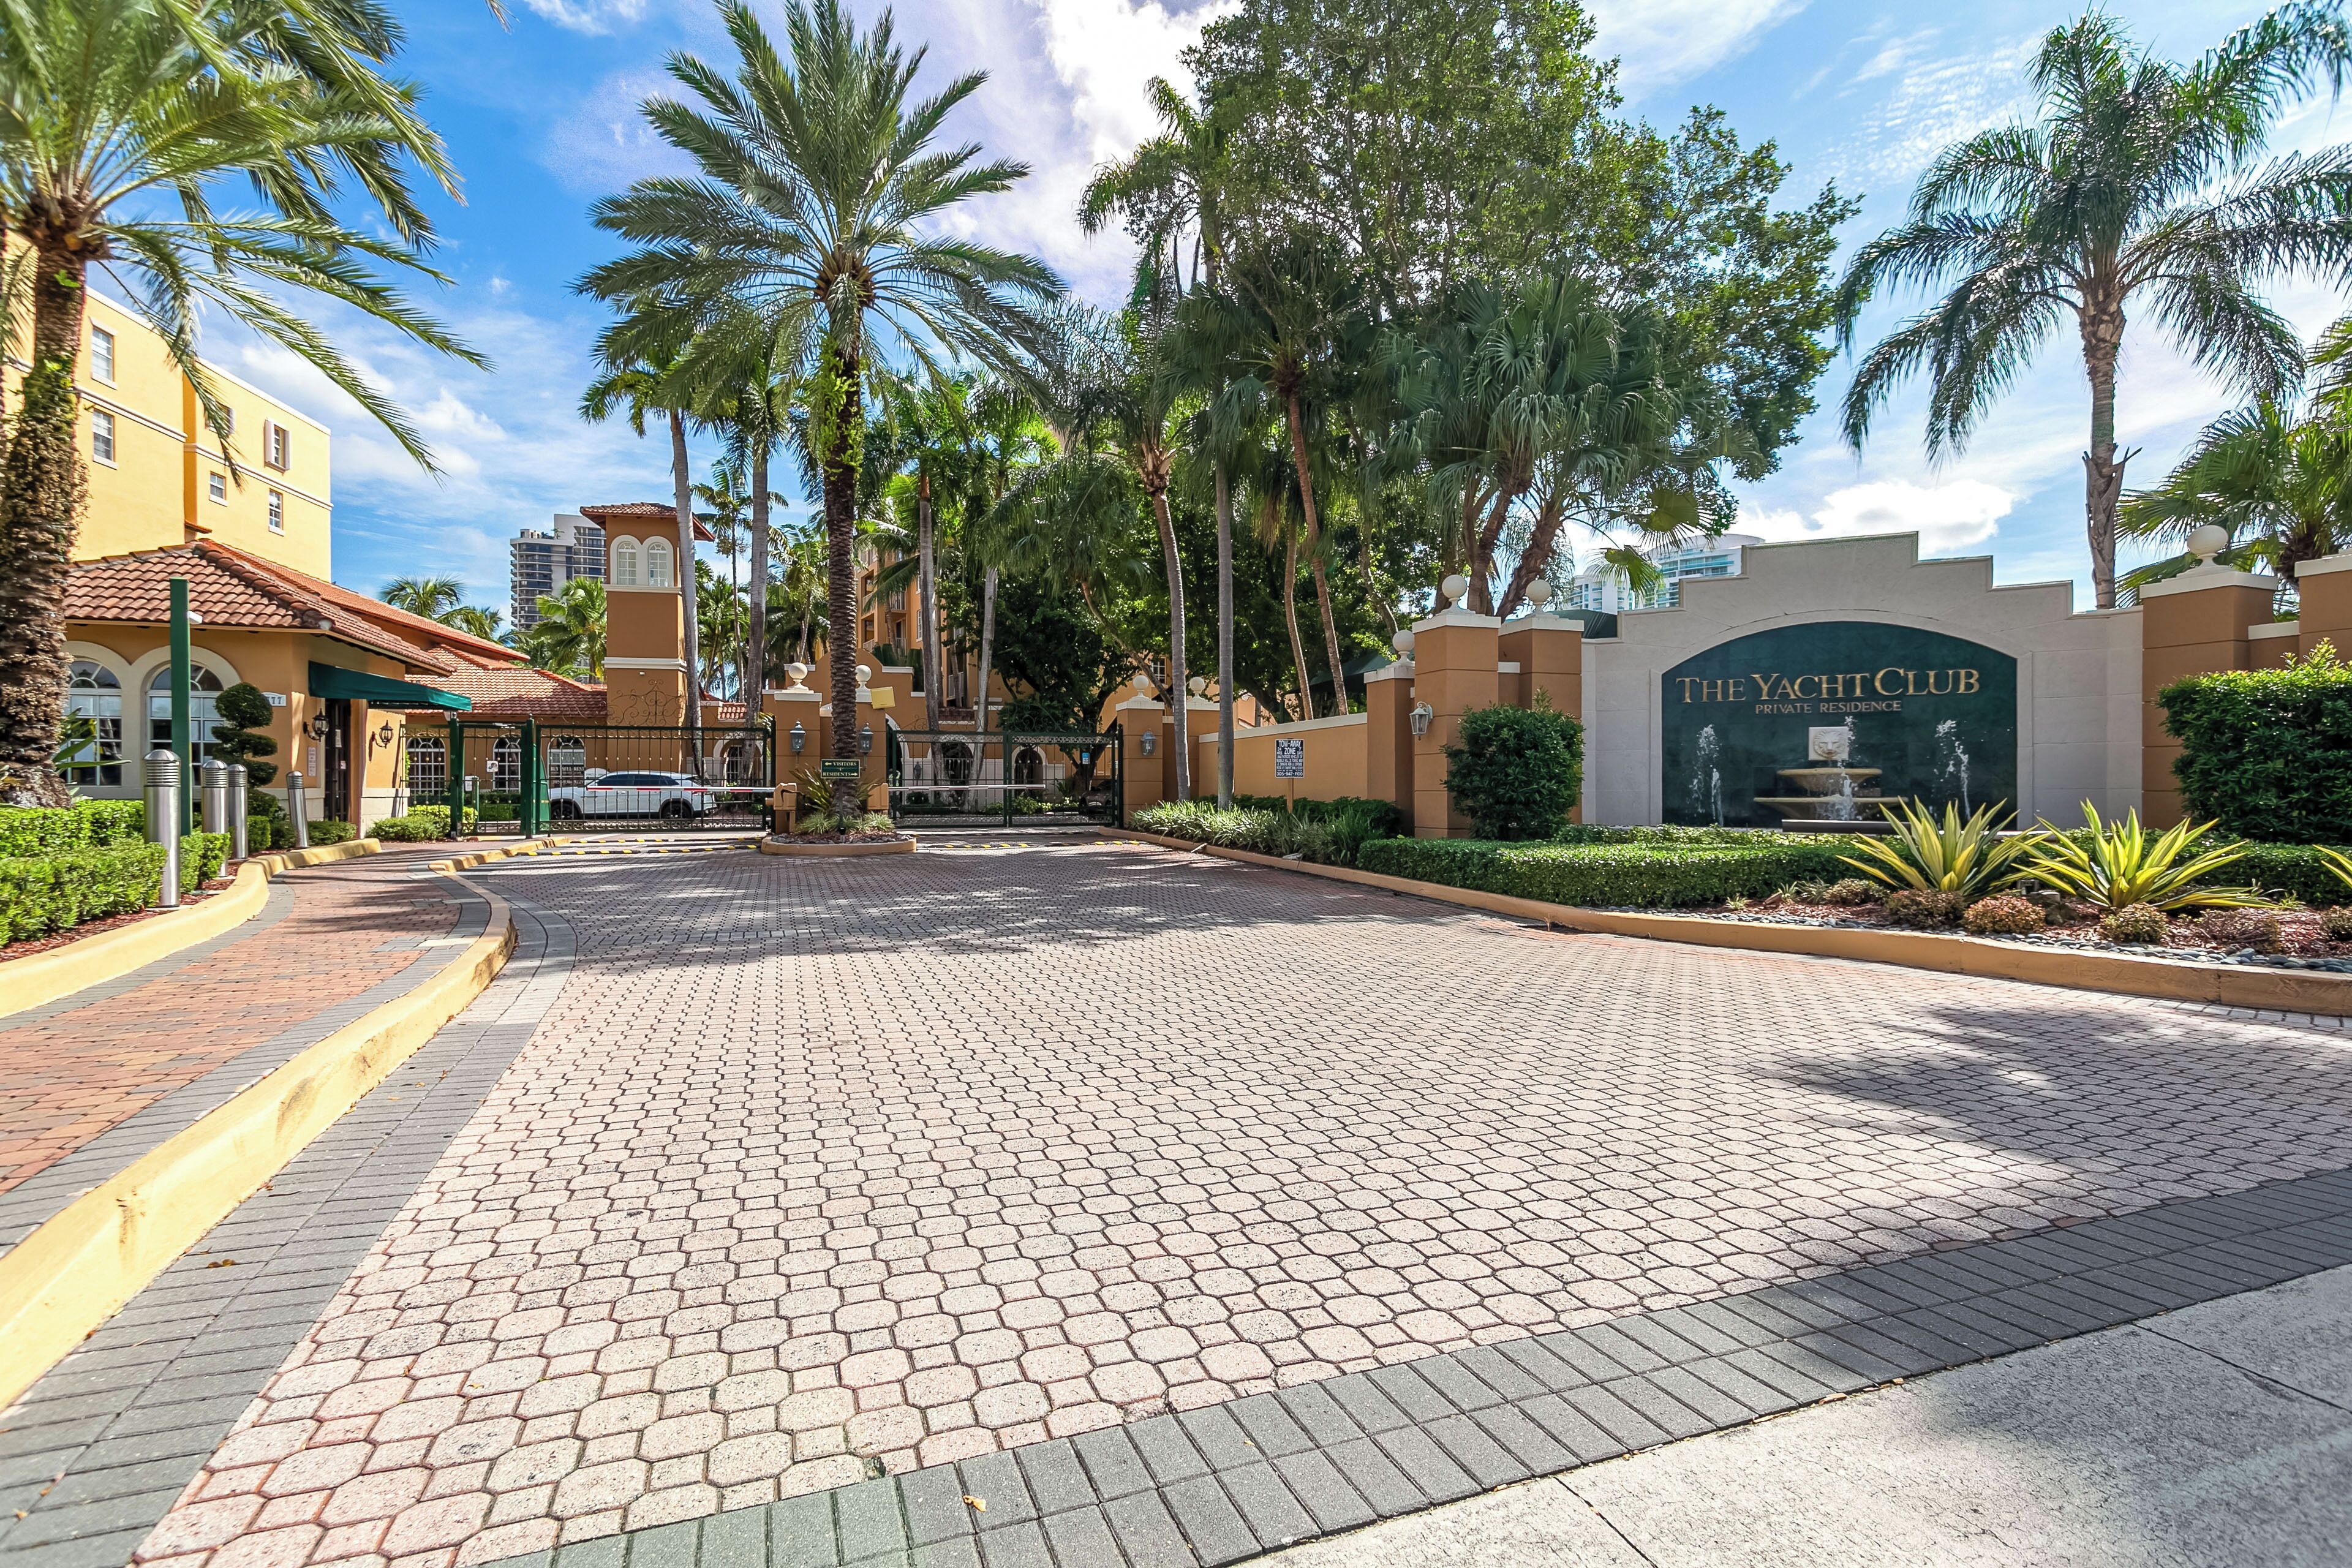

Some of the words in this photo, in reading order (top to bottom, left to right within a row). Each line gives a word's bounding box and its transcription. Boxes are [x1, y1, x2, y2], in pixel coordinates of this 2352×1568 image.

[1675, 677, 1746, 703] THE
[1750, 673, 1870, 699] YACHT
[1874, 667, 1980, 696] CLUB
[1755, 703, 1812, 714] PRIVATE
[1820, 700, 1902, 713] RESIDENCE
